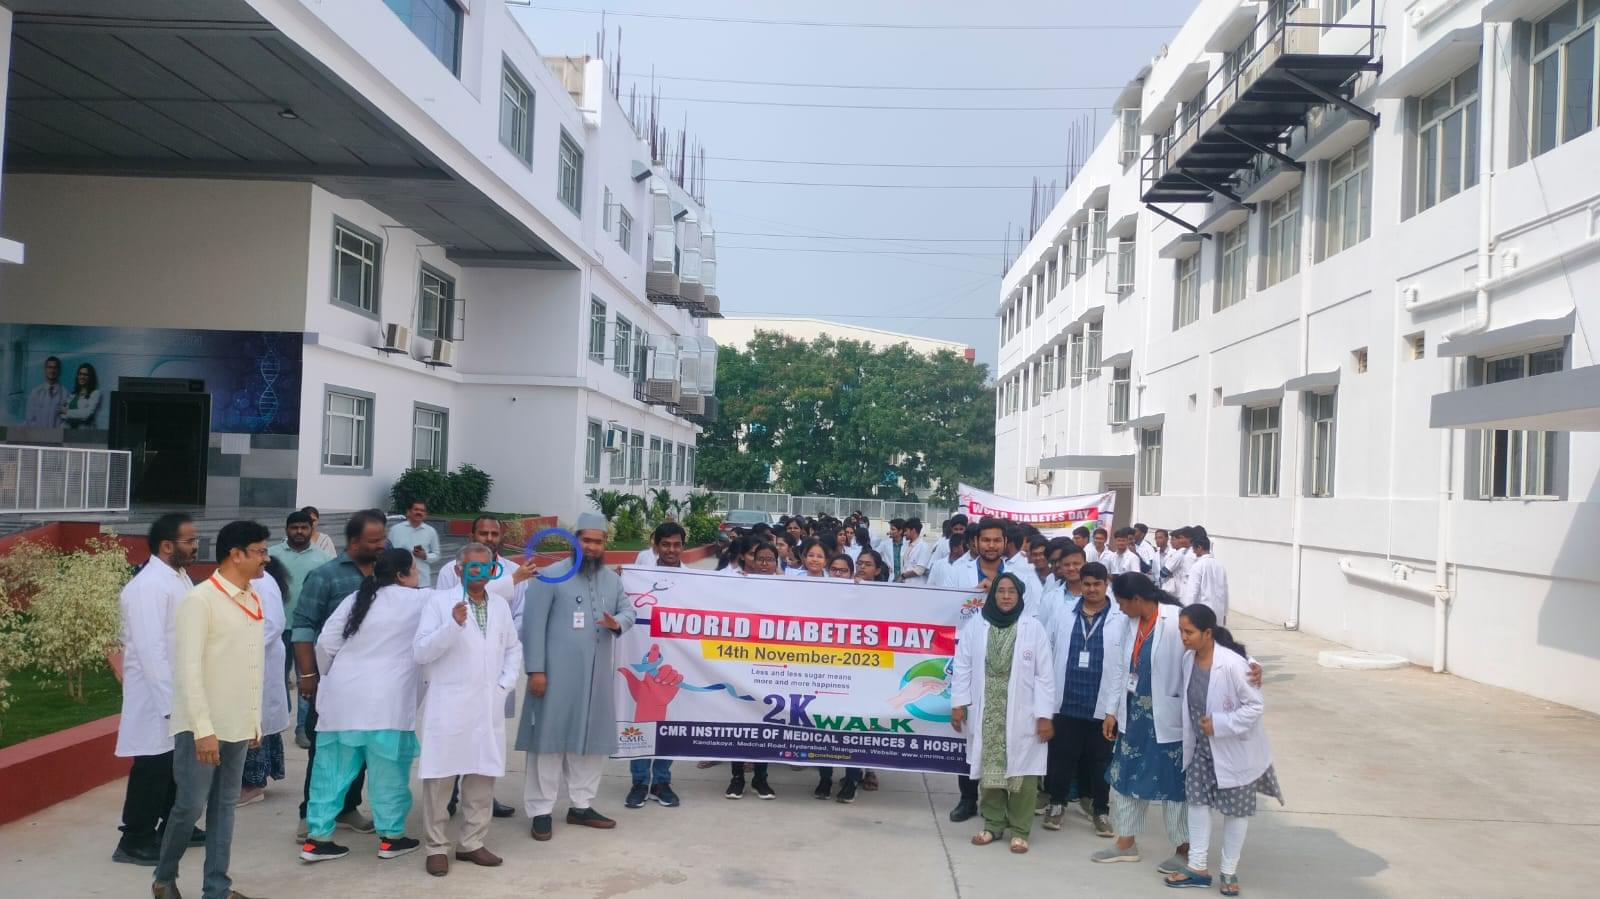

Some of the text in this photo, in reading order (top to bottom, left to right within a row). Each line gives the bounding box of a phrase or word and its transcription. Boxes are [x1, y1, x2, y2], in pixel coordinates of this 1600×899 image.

[1011, 513, 1065, 522] DIABETES
[1069, 511, 1090, 521] DAY
[659, 611, 935, 649] WORLD DIABETES DAY
[716, 644, 880, 667] 14th November-2023
[753, 678, 773, 686] more
[811, 681, 850, 690] happiness
[763, 693, 816, 729] 2K
[812, 714, 914, 733] WALK
[659, 725, 688, 737] CMR
[690, 726, 759, 739] INSTITUTE
[762, 728, 780, 740] OF
[782, 730, 839, 744] MEDICAL
[842, 735, 906, 749] SCIENCES
[909, 738, 919, 750] &
